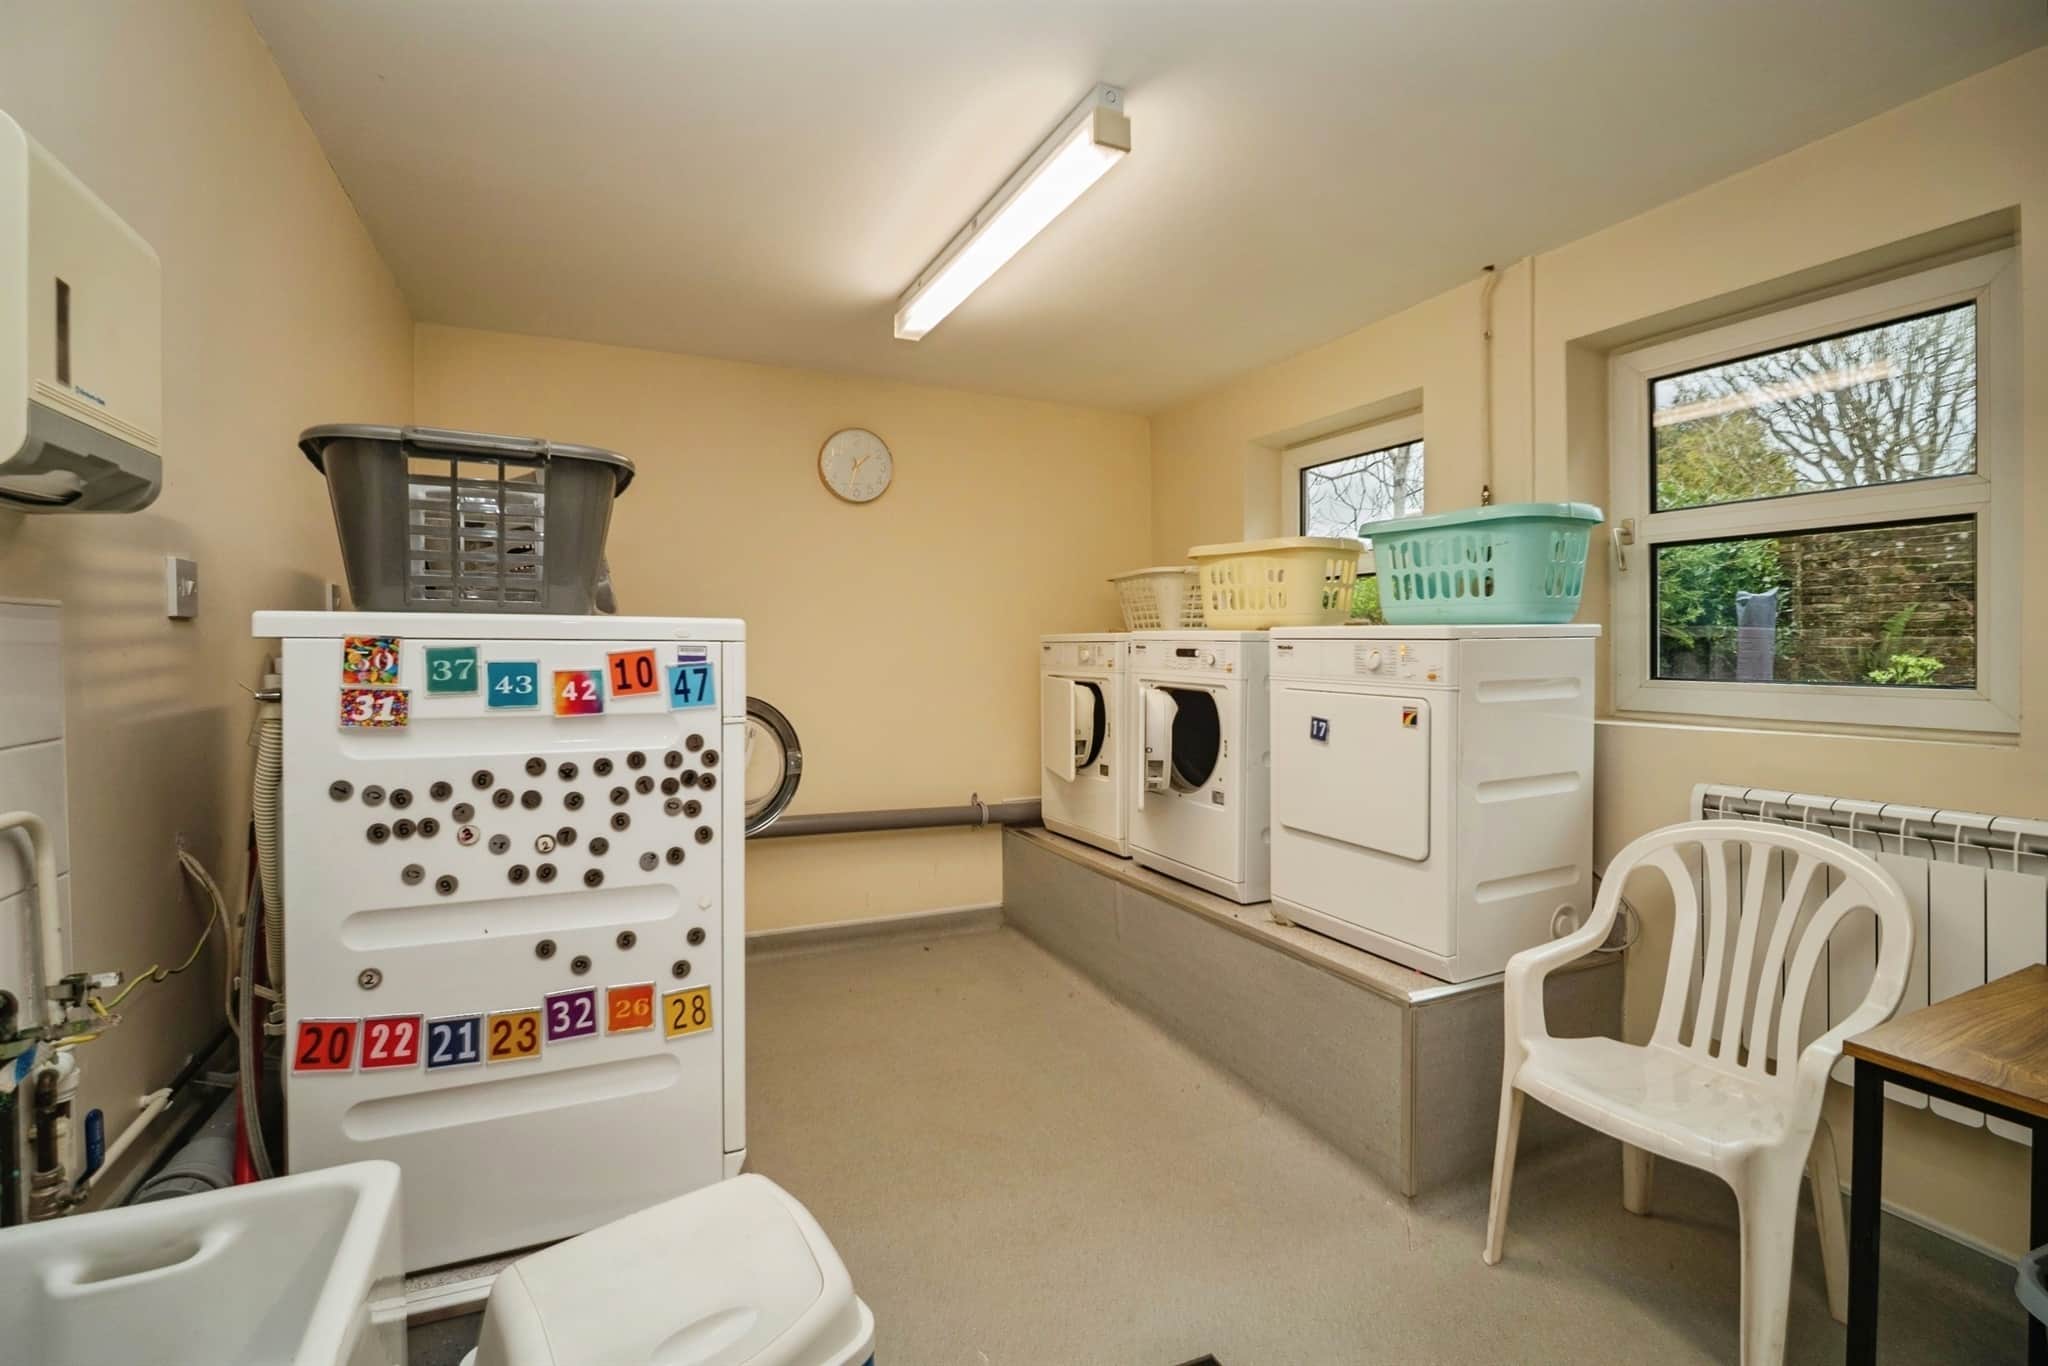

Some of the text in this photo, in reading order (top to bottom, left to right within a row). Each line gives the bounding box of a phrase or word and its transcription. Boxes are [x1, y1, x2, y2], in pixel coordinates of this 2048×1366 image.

[432, 658, 474, 681] 37
[494, 675, 533, 694] 43
[615, 656, 653, 690] 10
[562, 680, 597, 701] 42
[674, 668, 707, 703] 47
[352, 694, 396, 721] 31
[1312, 721, 1326, 737] 17
[462, 827, 474, 842] 3
[364, 974, 375, 986] 2
[552, 997, 593, 1033] 32
[615, 998, 650, 1019] 26
[673, 995, 706, 1031] 28
[301, 1027, 350, 1065] 20
[369, 1022, 414, 1060] 22
[432, 1022, 476, 1063] 21
[492, 1017, 537, 1056] 23
